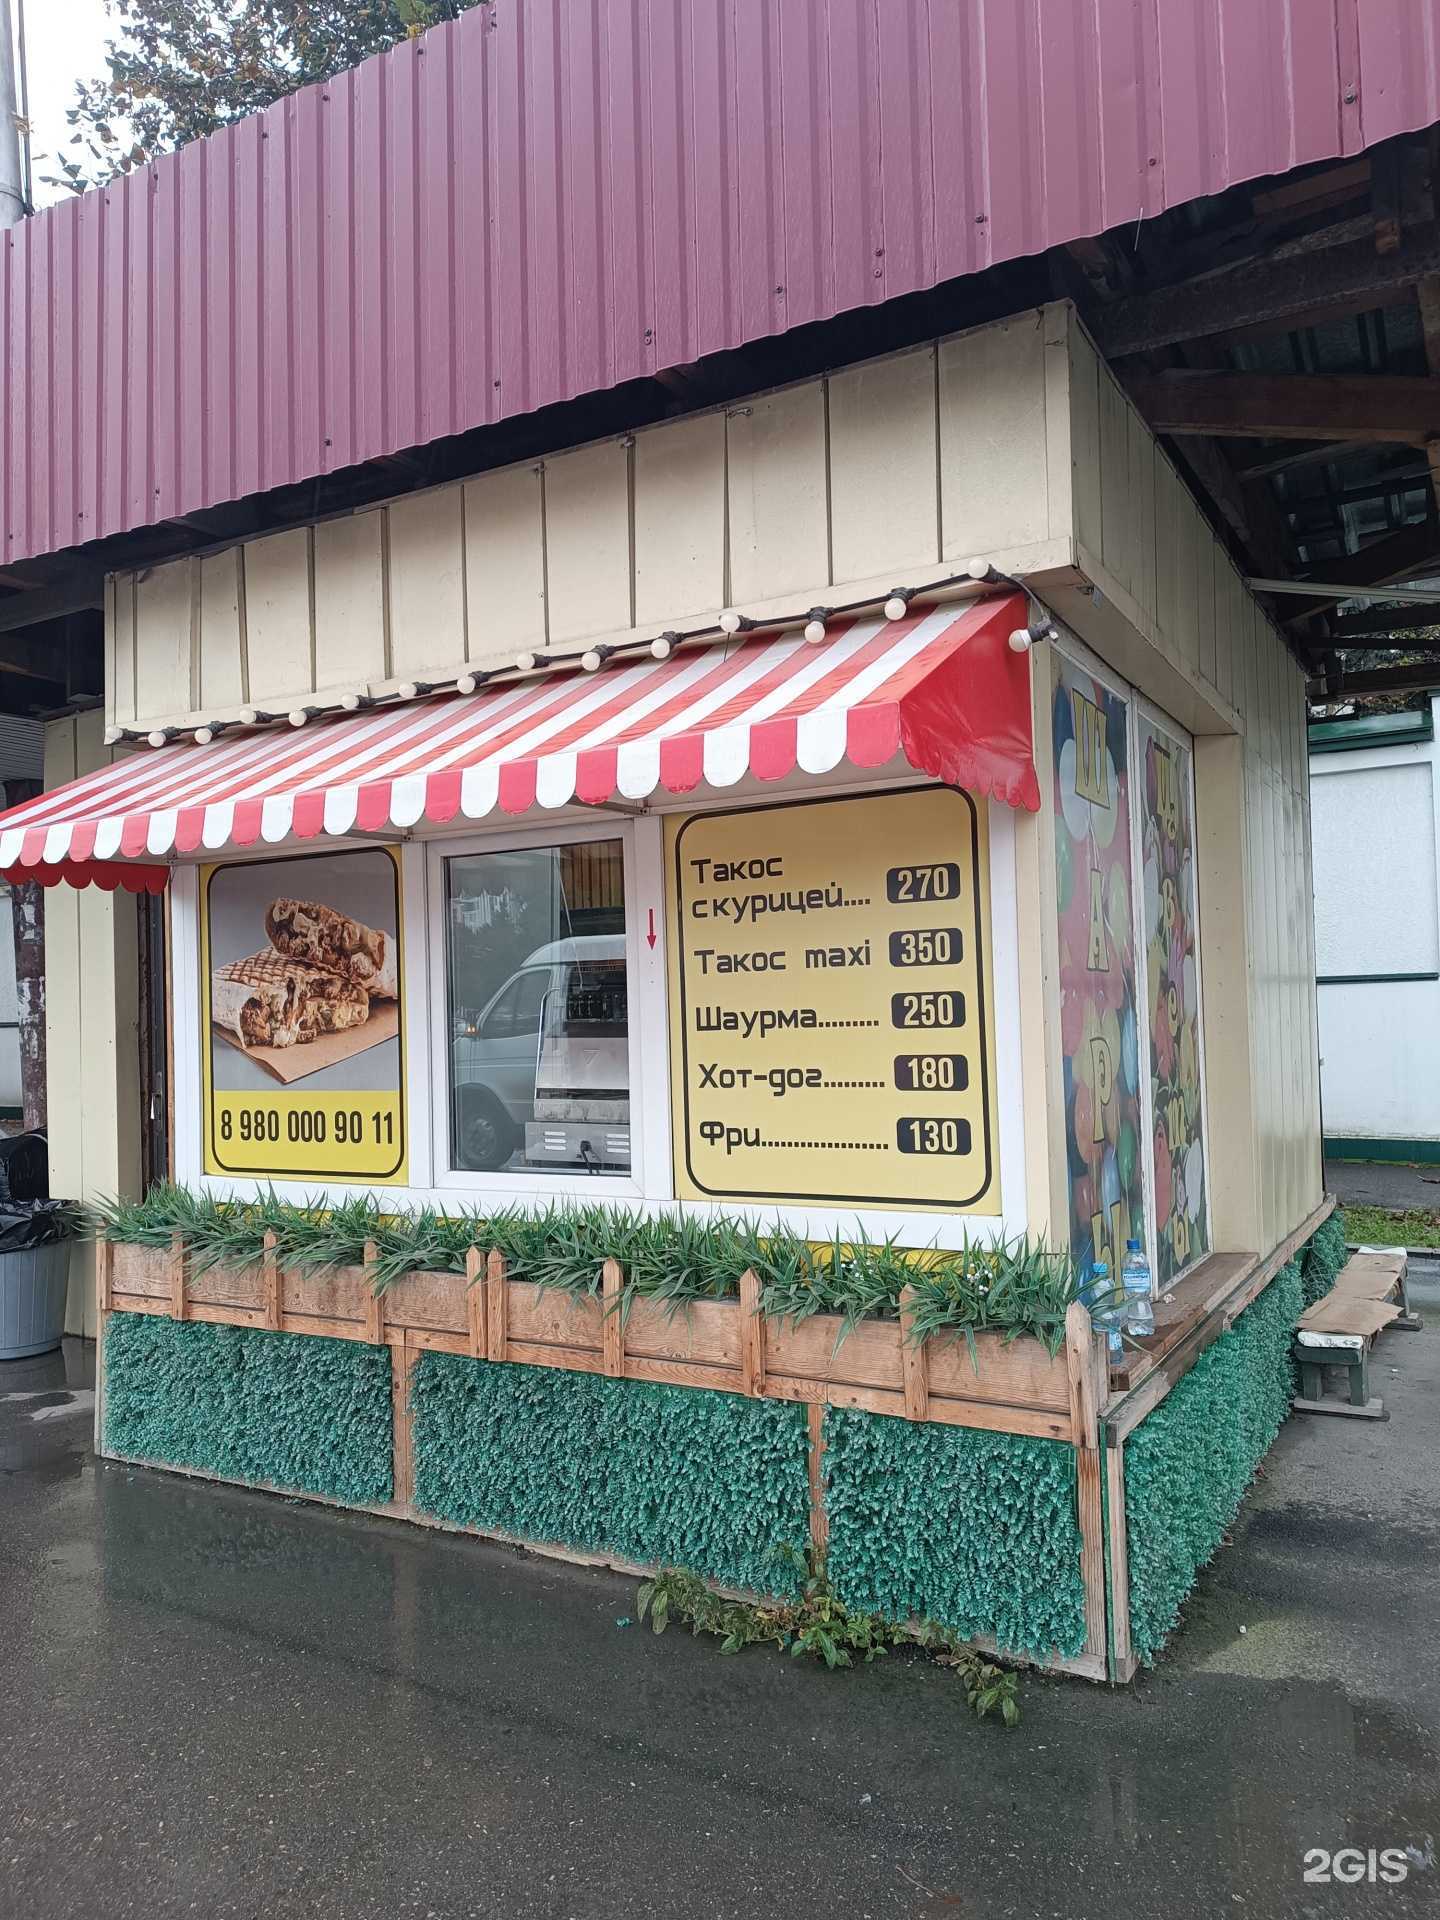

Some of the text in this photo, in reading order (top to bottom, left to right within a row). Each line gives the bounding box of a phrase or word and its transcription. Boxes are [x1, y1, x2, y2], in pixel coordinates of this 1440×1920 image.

[690, 857, 783, 883] Такос
[898, 866, 949, 900] 270
[694, 930, 951, 974] Такос maxi 350
[903, 994, 953, 1027] 250
[907, 1057, 954, 1089] 180
[221, 1109, 393, 1144] 8 980 000 90 11
[909, 1119, 958, 1152] 130
